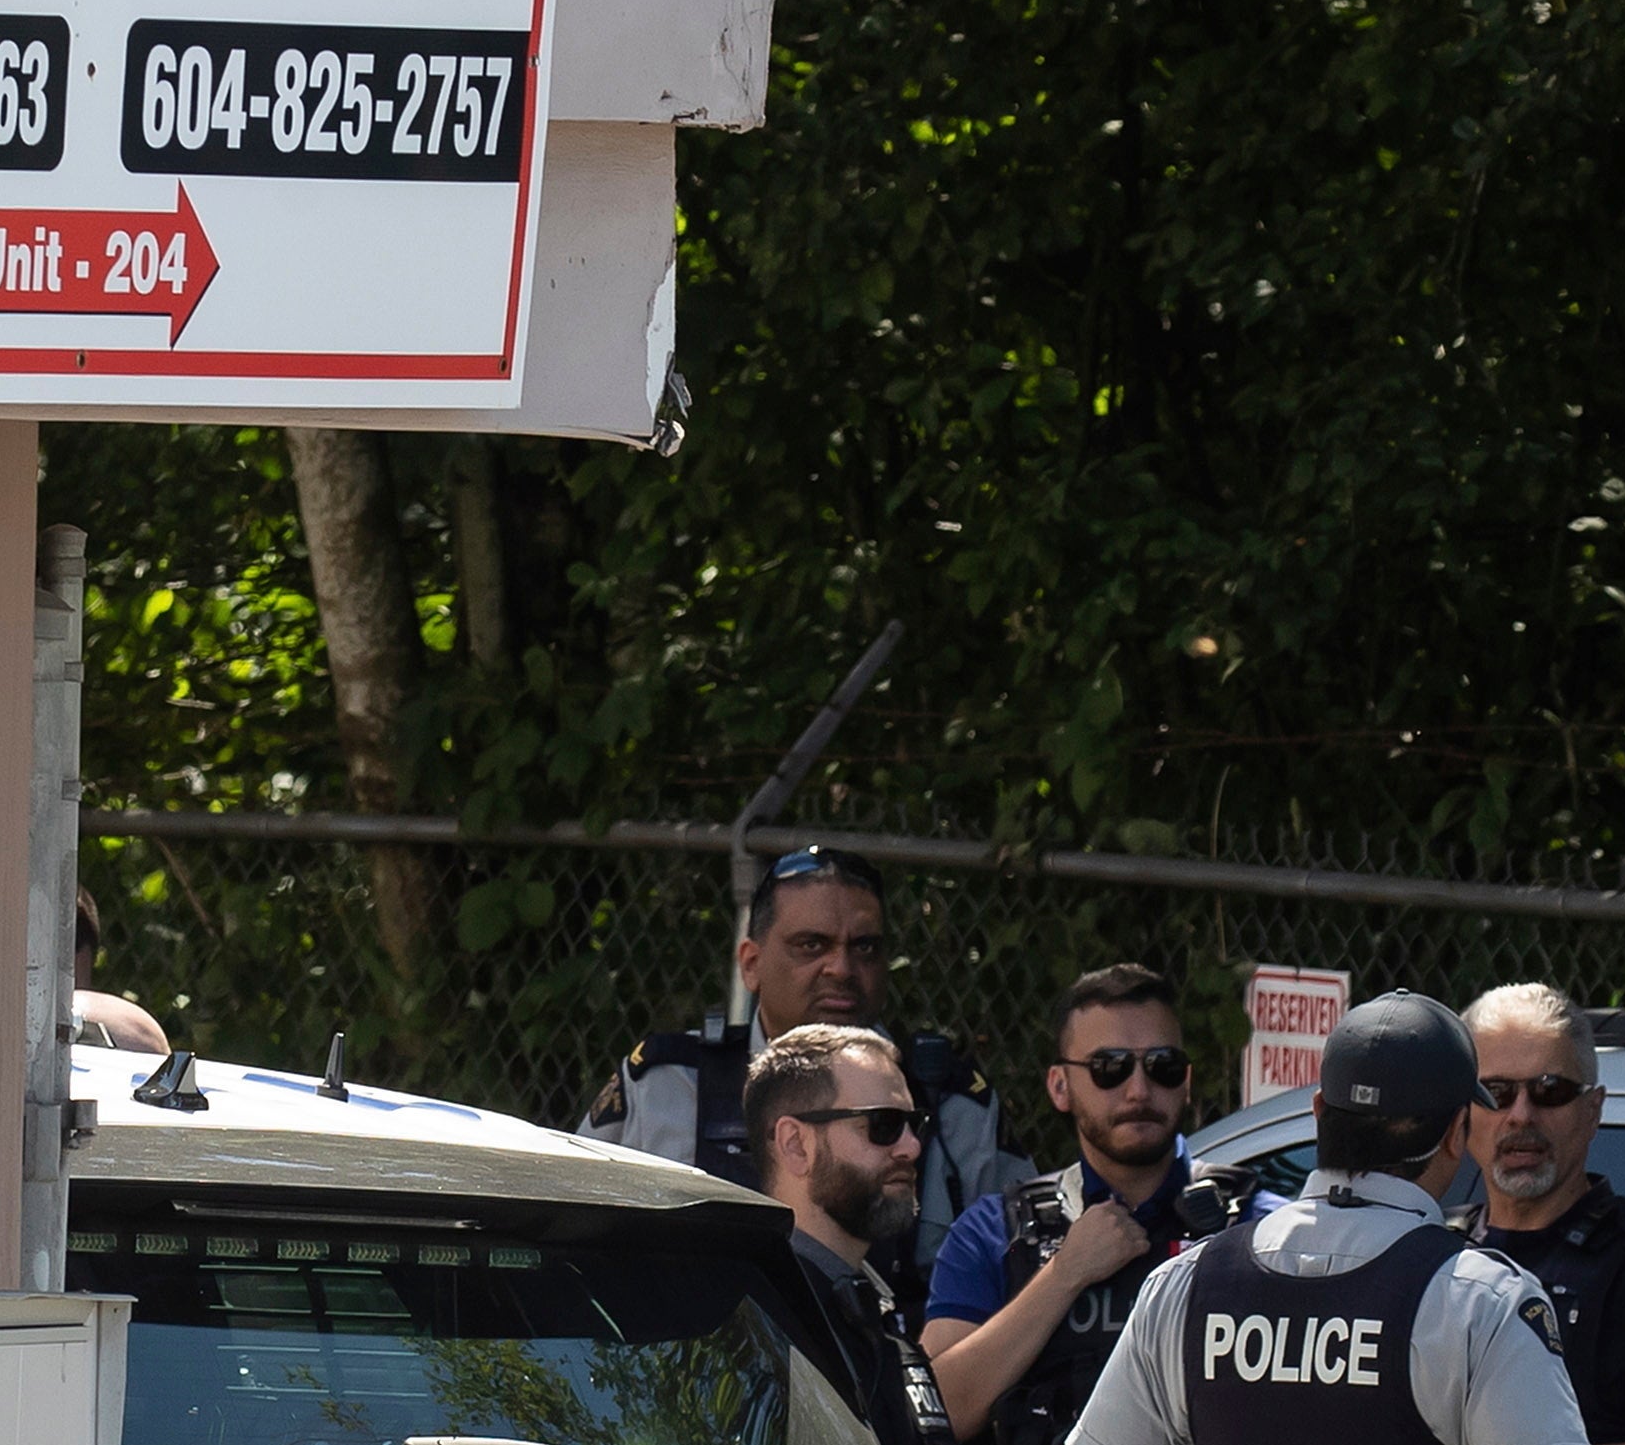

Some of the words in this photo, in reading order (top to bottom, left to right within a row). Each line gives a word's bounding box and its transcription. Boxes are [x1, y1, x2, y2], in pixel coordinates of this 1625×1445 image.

[144, 44, 514, 158] 604-825-2757
[103, 232, 188, 295] 204
[1256, 990, 1338, 1036] RESERVED
[1204, 1313, 1383, 1386] POLICE
